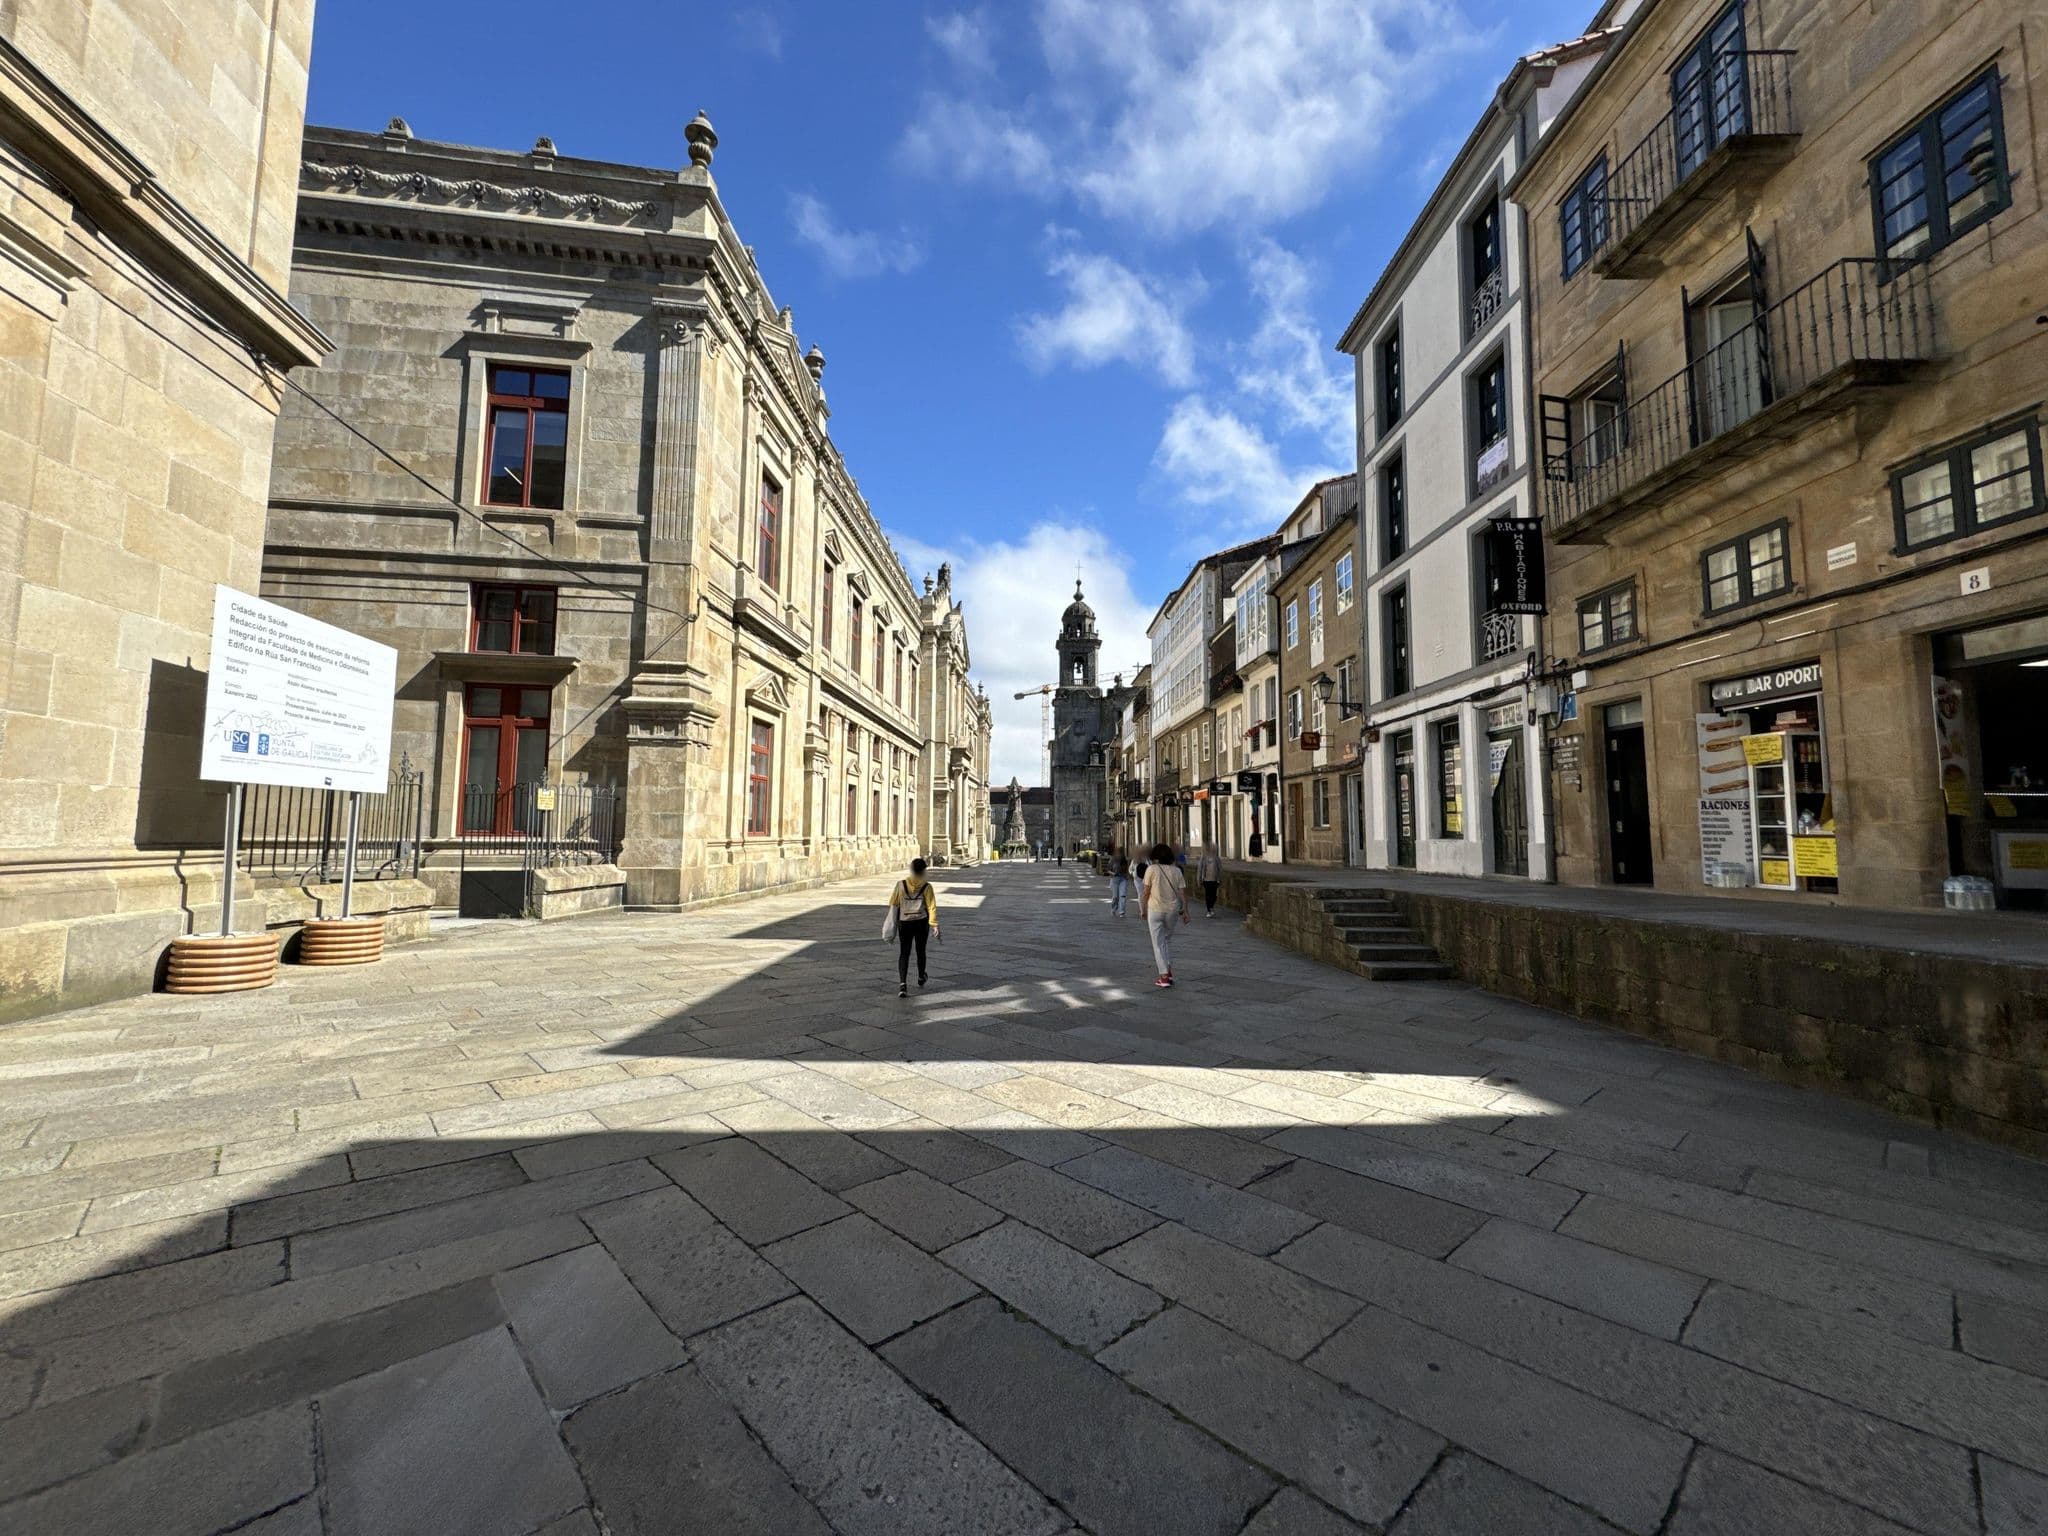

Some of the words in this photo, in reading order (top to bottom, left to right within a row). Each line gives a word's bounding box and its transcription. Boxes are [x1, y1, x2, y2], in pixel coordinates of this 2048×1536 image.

[1496, 522, 1516, 531] P.R.
[1513, 533, 1527, 602] HABITACIONES
[1970, 575, 1980, 589] 8
[231, 602, 256, 617] Cidade
[257, 612, 266, 621] da
[1501, 603, 1542, 611] OXFORD
[230, 614, 267, 632] Redacción
[269, 628, 278, 636] do
[257, 636, 267, 645] da
[300, 649, 307, 657] de
[255, 648, 264, 656] na
[279, 655, 292, 664] San
[293, 657, 322, 672] Francisco
[1747, 675, 1772, 694] BAR
[1776, 664, 1822, 688] OPORT
[1700, 800, 1750, 810] RACIONES
